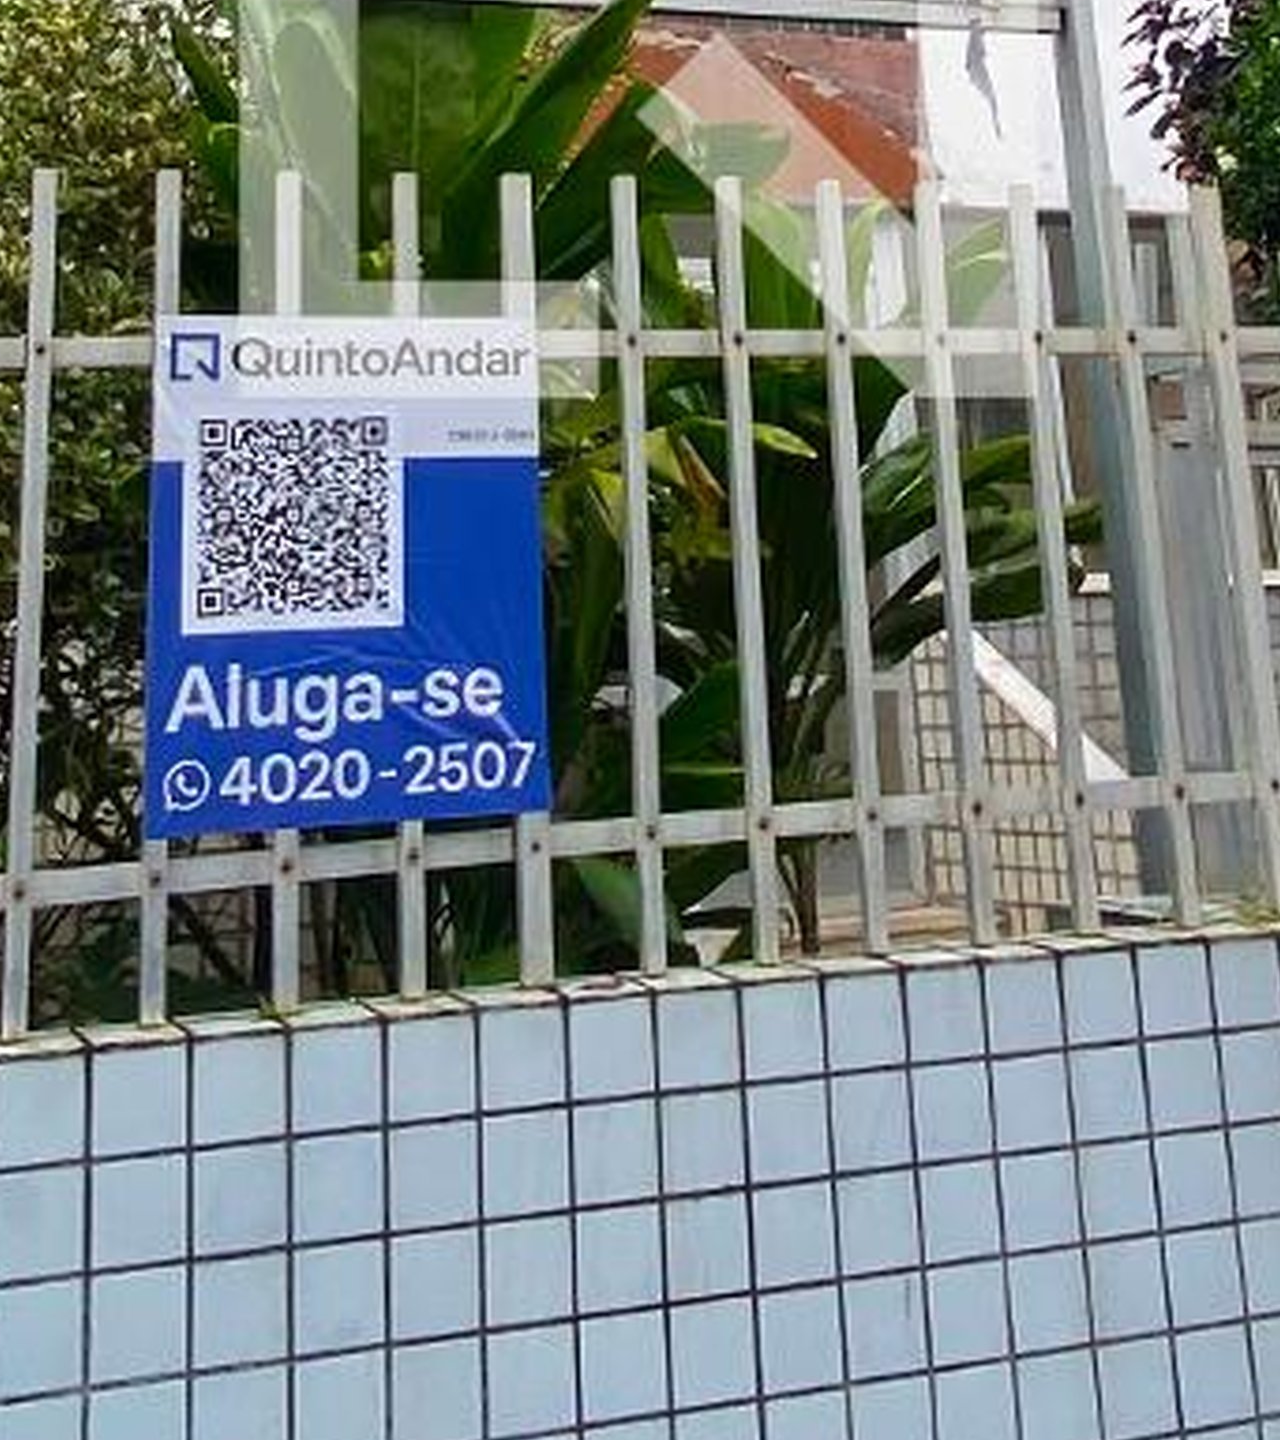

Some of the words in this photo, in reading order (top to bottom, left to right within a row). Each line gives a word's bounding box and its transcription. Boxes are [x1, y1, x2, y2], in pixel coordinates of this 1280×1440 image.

[231, 337, 530, 379] QuintoAndar
[164, 663, 504, 742] Aluga-se
[219, 741, 536, 806] 4020-2507
